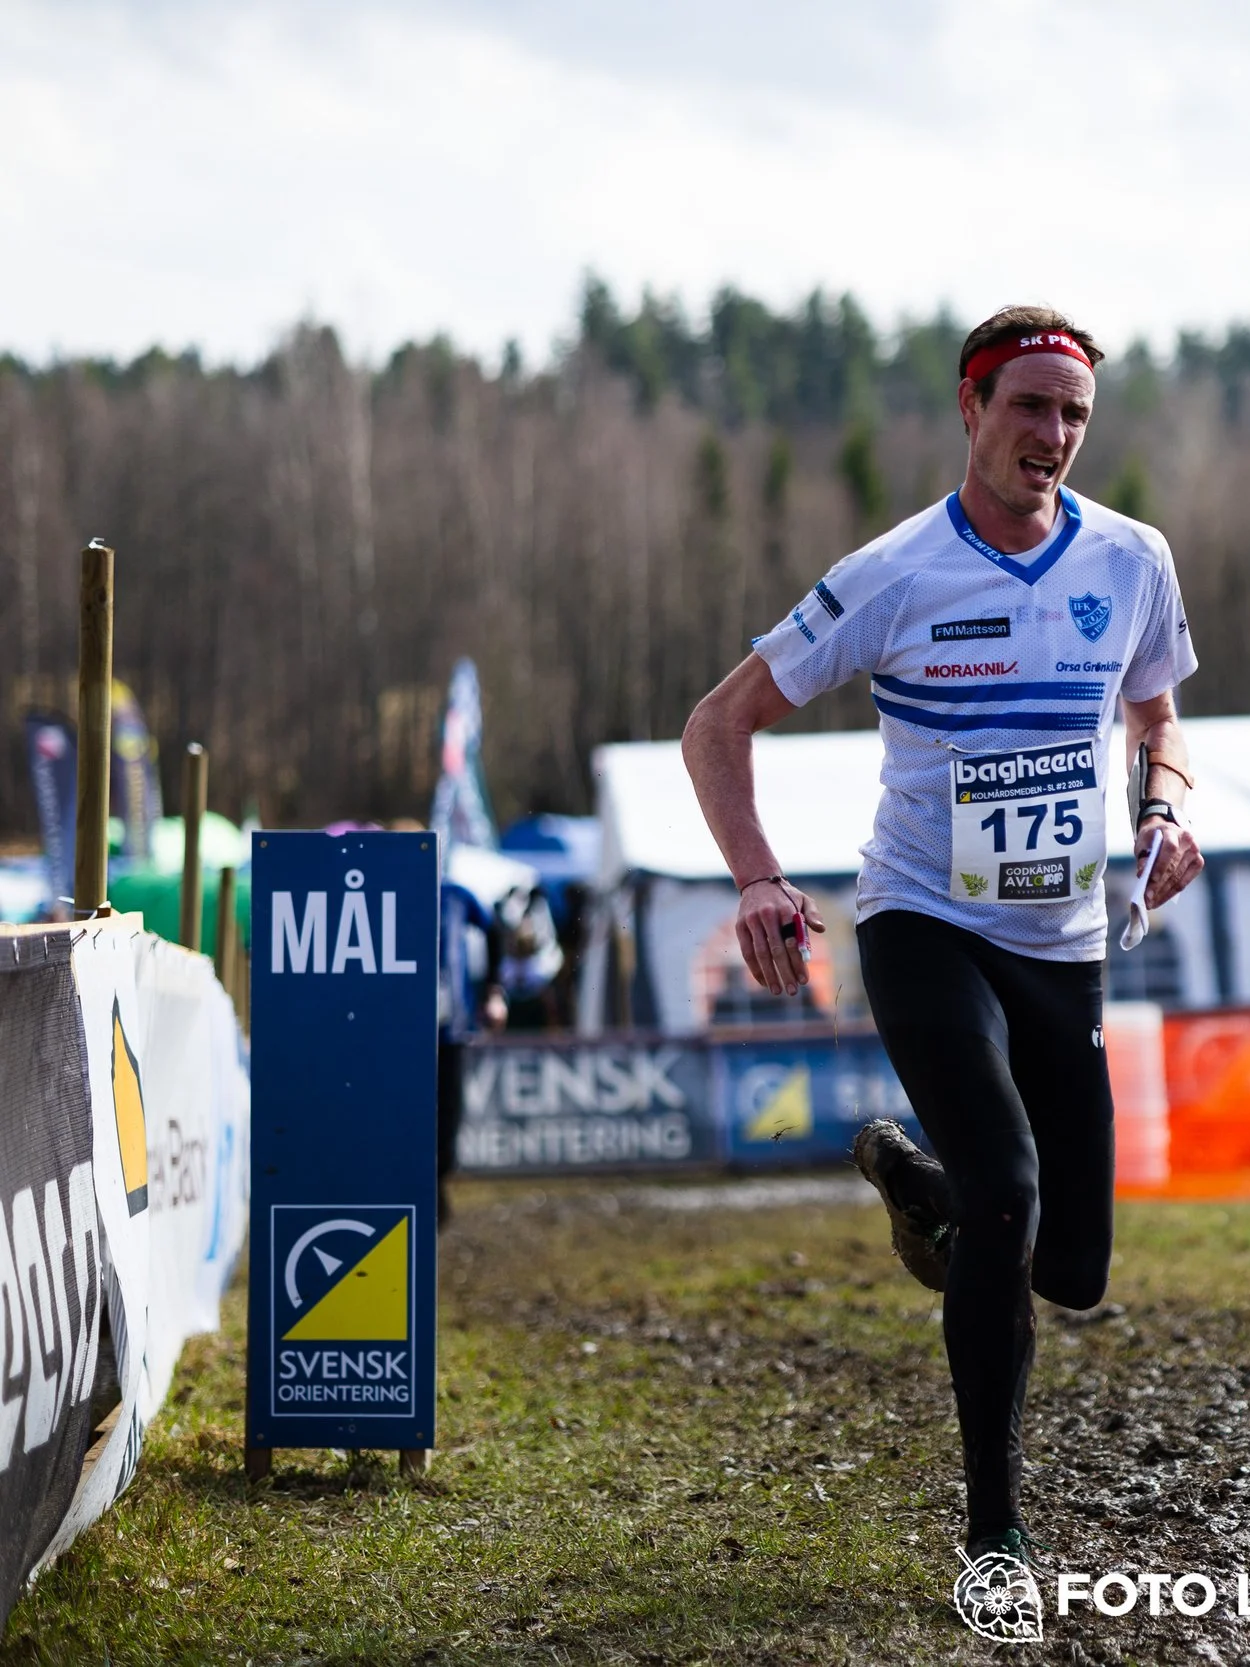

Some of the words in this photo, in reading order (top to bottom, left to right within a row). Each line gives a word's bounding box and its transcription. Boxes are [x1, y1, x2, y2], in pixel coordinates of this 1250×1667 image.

[1020, 335, 1043, 348] SK
[962, 528, 1004, 561] TRIMTEX
[1073, 602, 1091, 611] IFK
[1080, 605, 1109, 628] MORA
[955, 624, 1007, 636] Mattsson
[1056, 662, 1080, 673] Orsa
[955, 749, 1093, 785] bagheera
[972, 786, 1042, 800] KOLMÅRDSMEDELN
[1047, 783, 1055, 792] SL
[1056, 782, 1066, 790] #2
[1068, 780, 1084, 789] 2026
[981, 799, 1083, 853] 175
[1005, 863, 1064, 876] GODKÄNDA
[1004, 873, 1064, 887] AVLOPP
[271, 868, 417, 974] MÅL
[462, 1046, 686, 1117] VENSK
[279, 1351, 409, 1380] SVENSK
[277, 1384, 409, 1403] ORIENTERING
